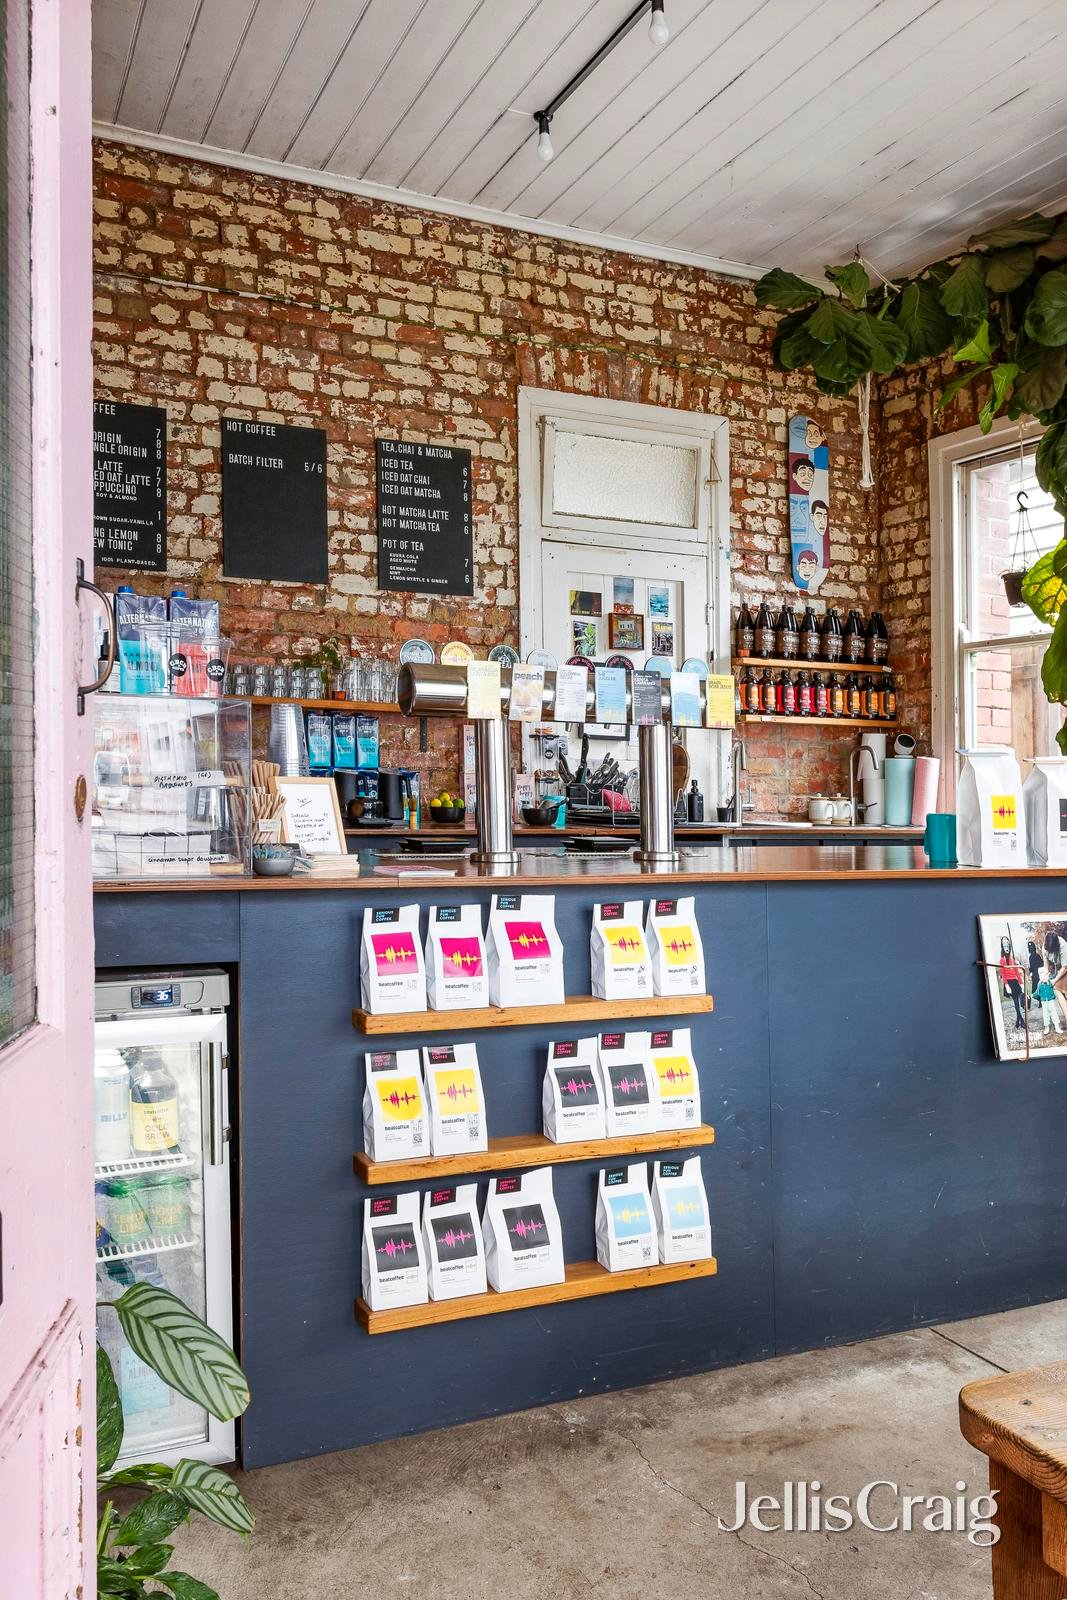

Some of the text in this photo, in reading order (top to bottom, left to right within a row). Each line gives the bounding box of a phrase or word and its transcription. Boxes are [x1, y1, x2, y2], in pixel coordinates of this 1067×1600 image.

[156, 428, 161, 438] 7
[227, 421, 276, 436] HOT COFFEE
[156, 439, 161, 448] 8
[118, 445, 147, 458] ORIGIN
[156, 450, 161, 459] 8
[418, 447, 422, 455] &
[426, 448, 452, 459] MATCHA
[98, 460, 161, 476] LATTE 7
[229, 454, 253, 465] BATCH
[256, 457, 283, 469] FILTER
[382, 458, 467, 476] ICED TEA 6
[107, 472, 122, 482] OAT
[126, 474, 150, 486] LATTE
[156, 477, 161, 487] 7
[382, 471, 467, 489] ICED OAT CHAI 7
[157, 488, 161, 497] 8
[382, 484, 468, 502] ICED OAT MATCHA 8
[382, 505, 468, 522] HOT MATCHA LATTE 8
[382, 518, 468, 534] HOT MATCHA TEA 6
[109, 529, 138, 541] LEMON
[157, 533, 161, 543] 8
[108, 539, 133, 551] TONIC
[157, 544, 161, 553] 8
[382, 539, 424, 551] POT OF TEA
[464, 559, 468, 567] 7
[465, 575, 469, 583] 6
[120, 614, 164, 624] ALTERNA
